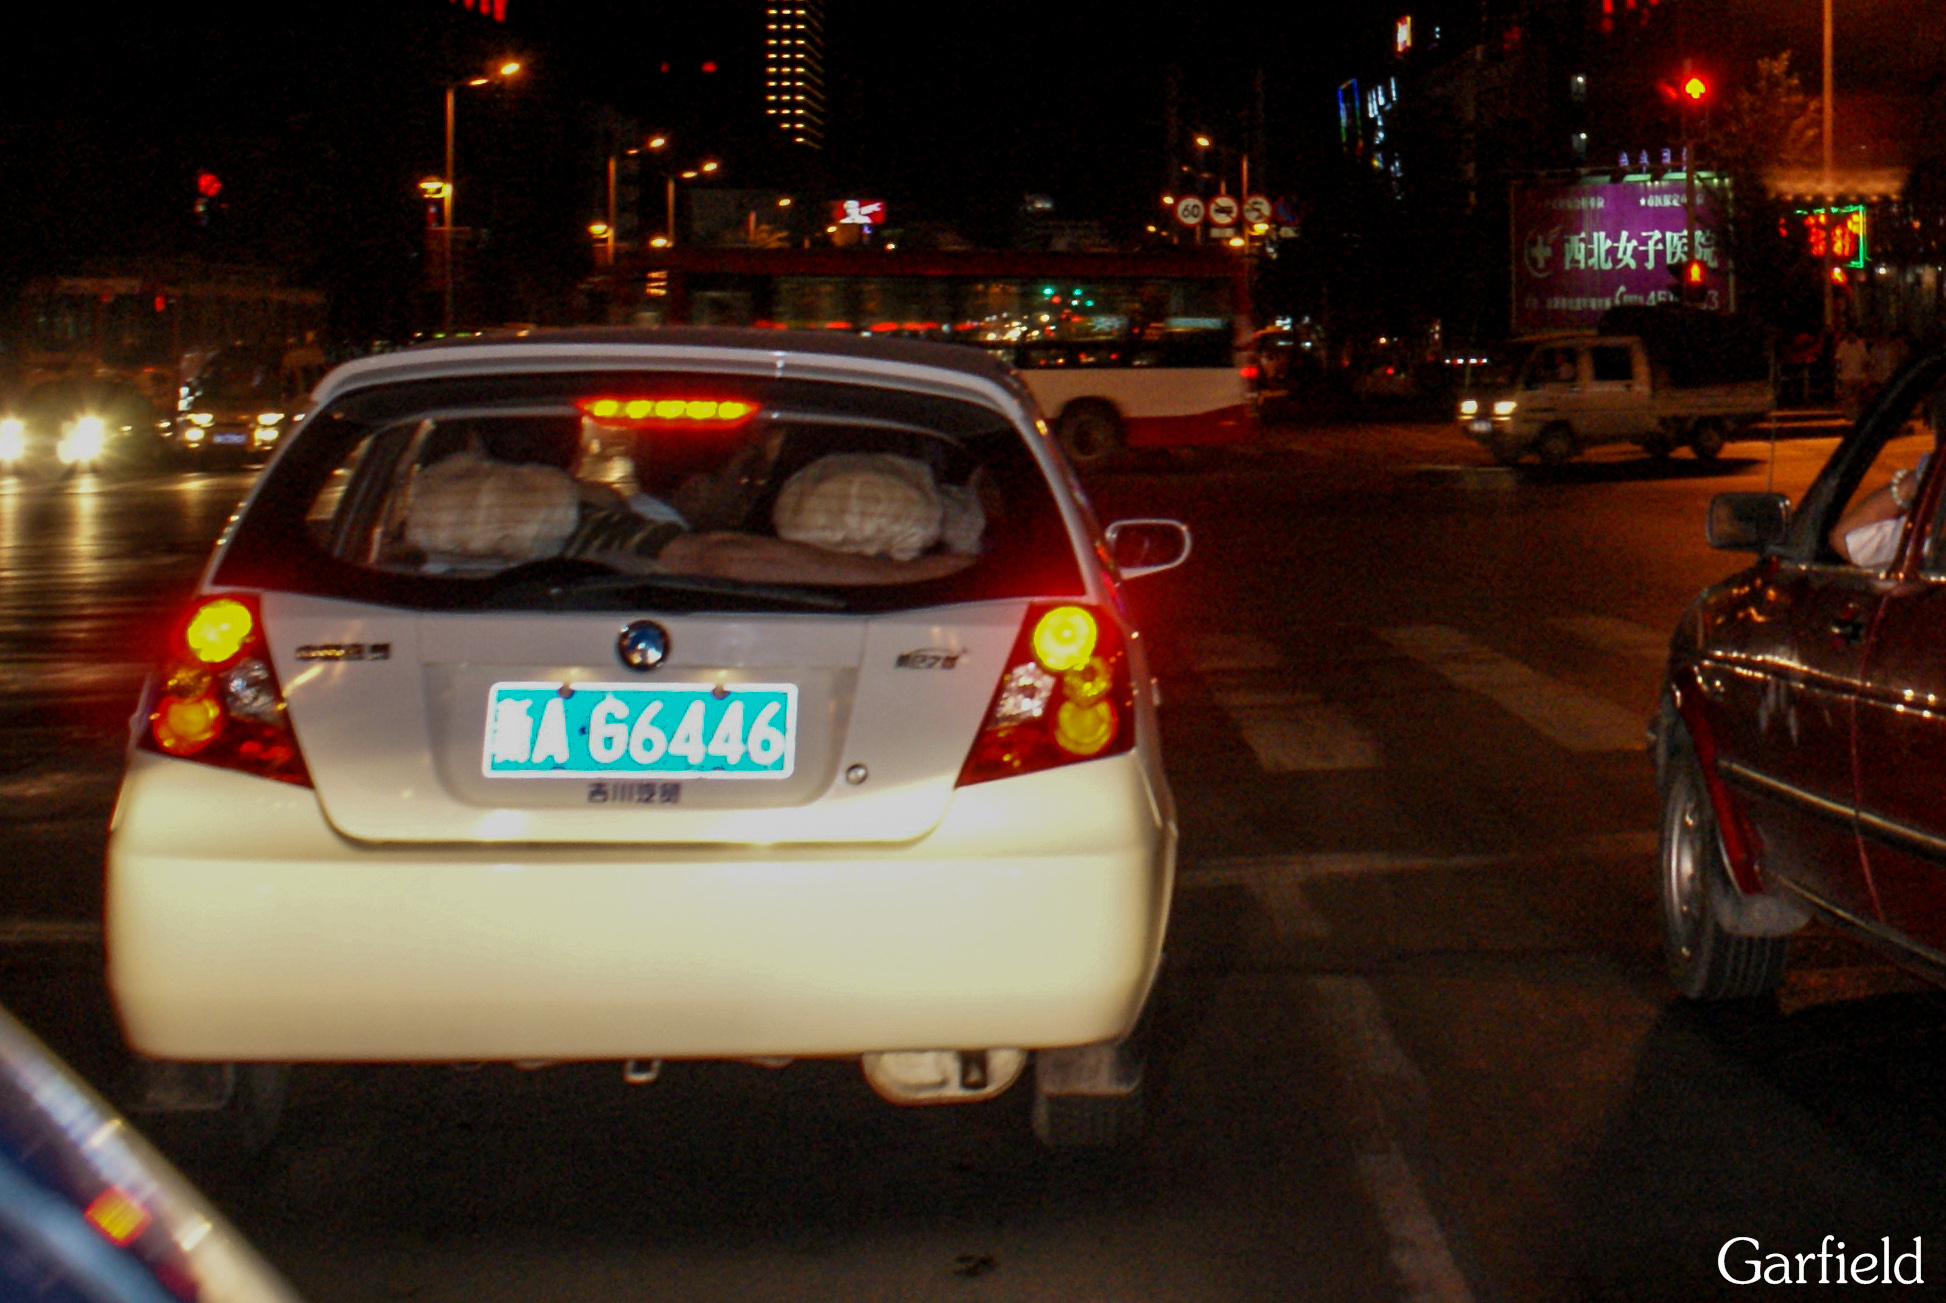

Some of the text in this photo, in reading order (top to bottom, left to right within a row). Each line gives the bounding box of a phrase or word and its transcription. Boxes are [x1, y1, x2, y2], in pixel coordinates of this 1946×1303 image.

[1181, 203, 1201, 219] 60
[1563, 229, 1718, 269] 西北女子医院
